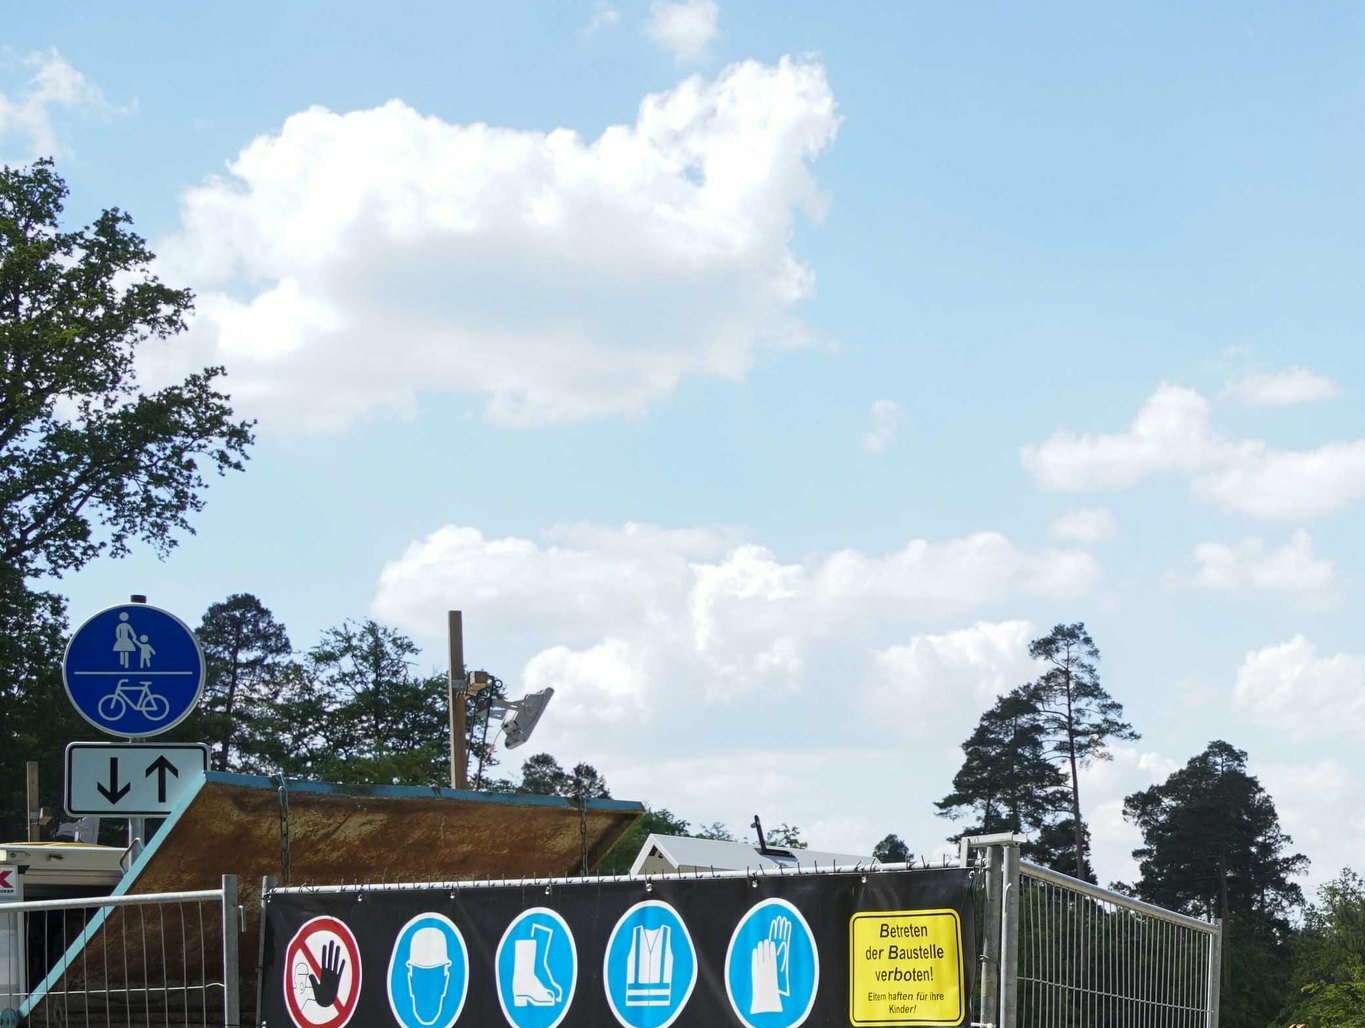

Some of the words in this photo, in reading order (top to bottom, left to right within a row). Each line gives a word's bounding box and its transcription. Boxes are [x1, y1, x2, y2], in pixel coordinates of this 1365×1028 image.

[879, 923, 928, 938] Betreten
[865, 945, 884, 960] der
[887, 944, 944, 960] Baustelle
[874, 966, 934, 982] verboten!
[867, 992, 887, 1002] Eltern
[887, 991, 914, 1001] haften
[916, 991, 928, 1001] für
[929, 991, 945, 1001] ihre
[888, 1004, 917, 1014] Kinder!
